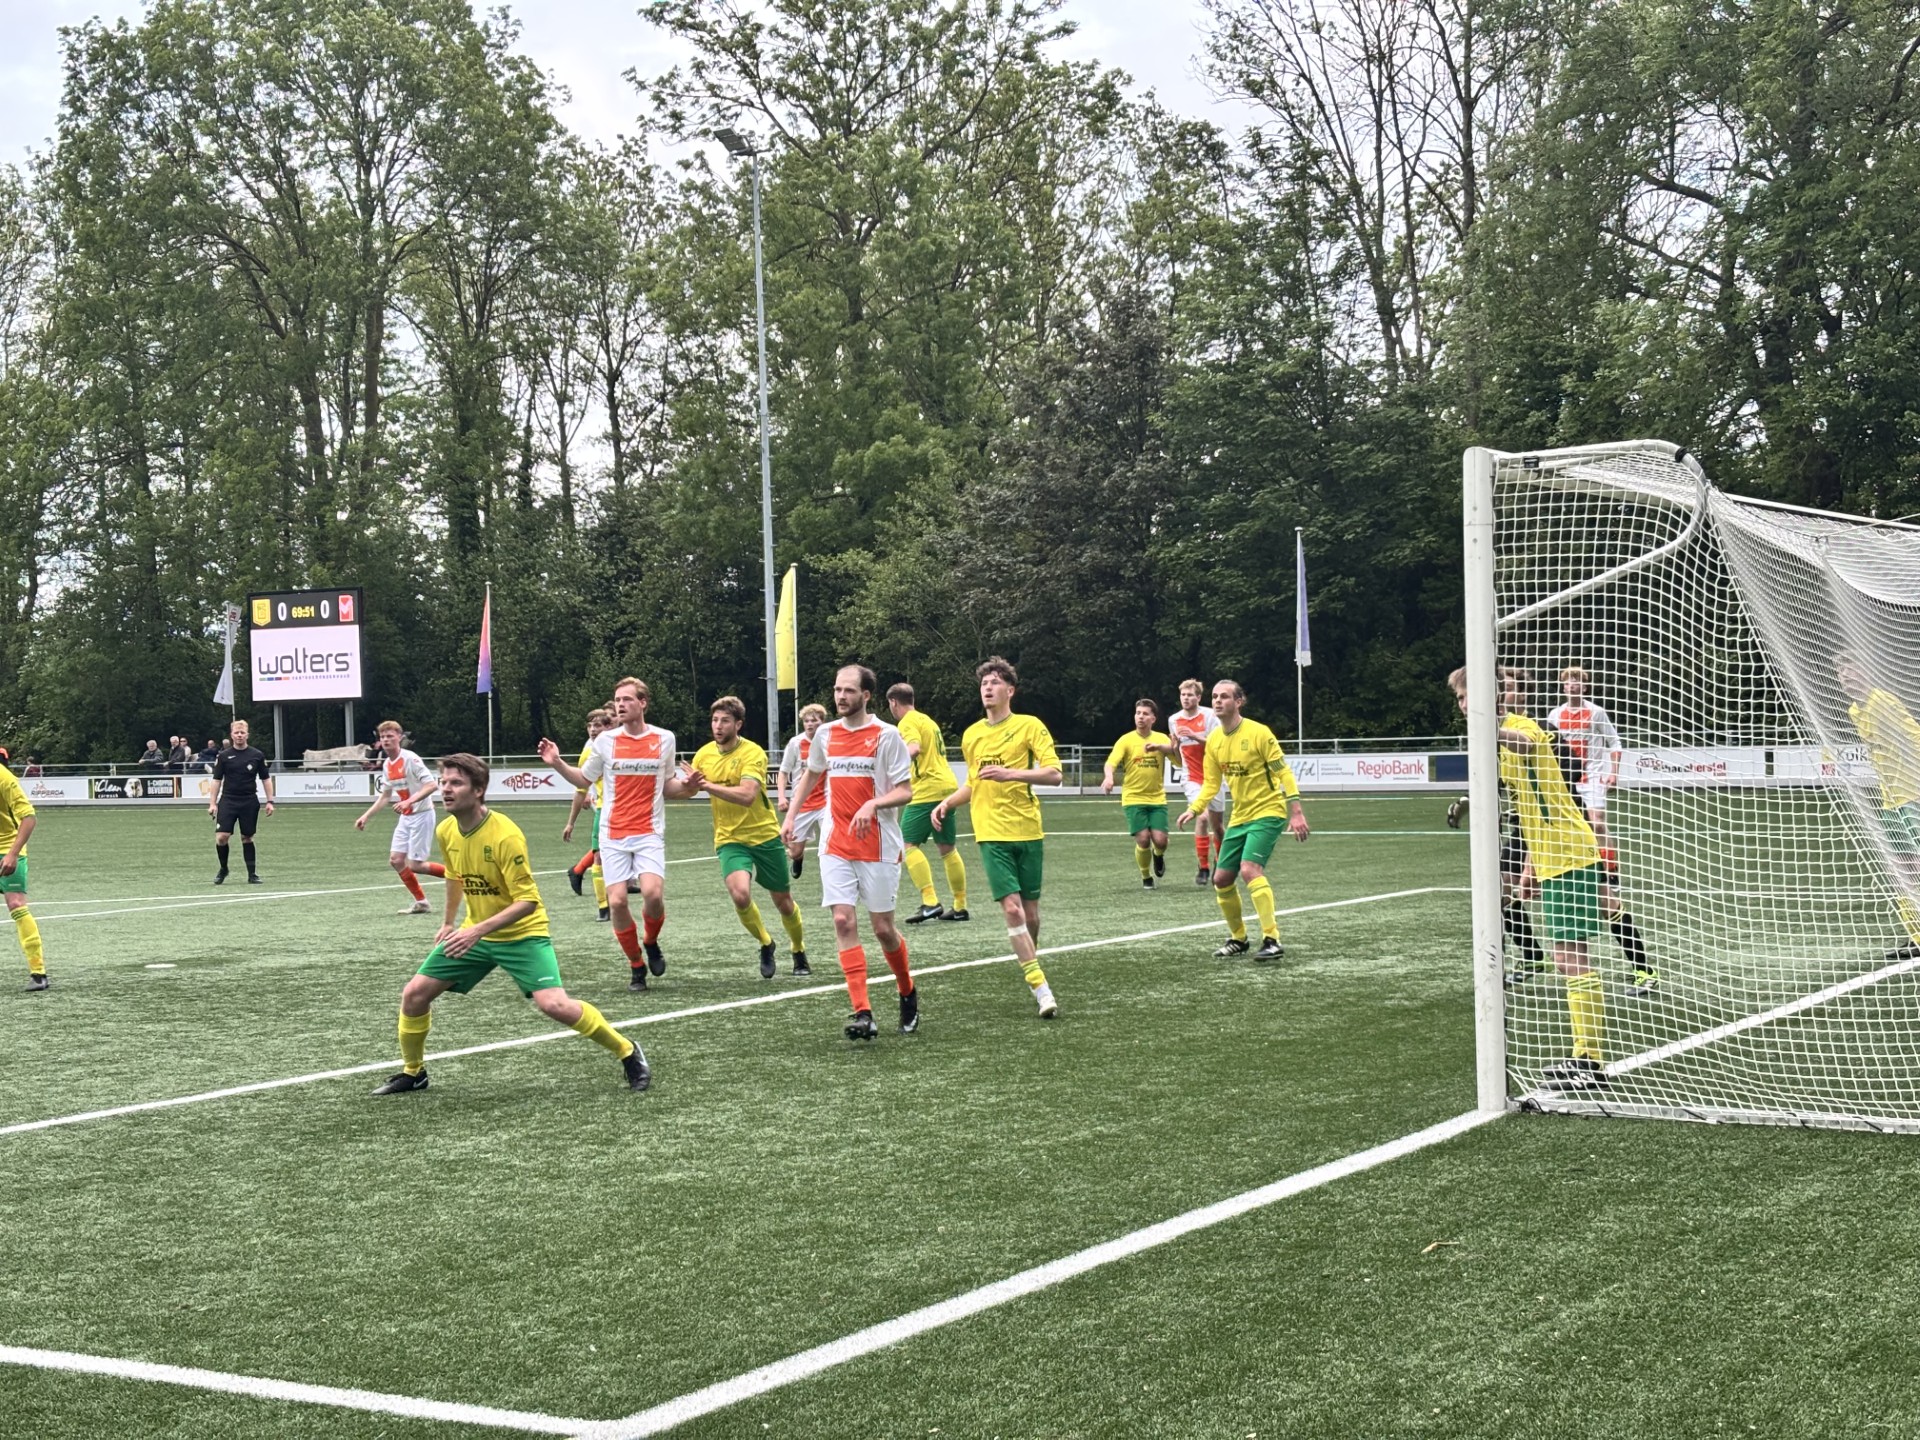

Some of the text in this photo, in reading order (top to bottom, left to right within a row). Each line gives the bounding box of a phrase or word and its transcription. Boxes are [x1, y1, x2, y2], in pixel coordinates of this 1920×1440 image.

[277, 600, 330, 621] 0 69:51 0
[258, 647, 350, 675] wolters
[1357, 759, 1425, 779] RegioBank
